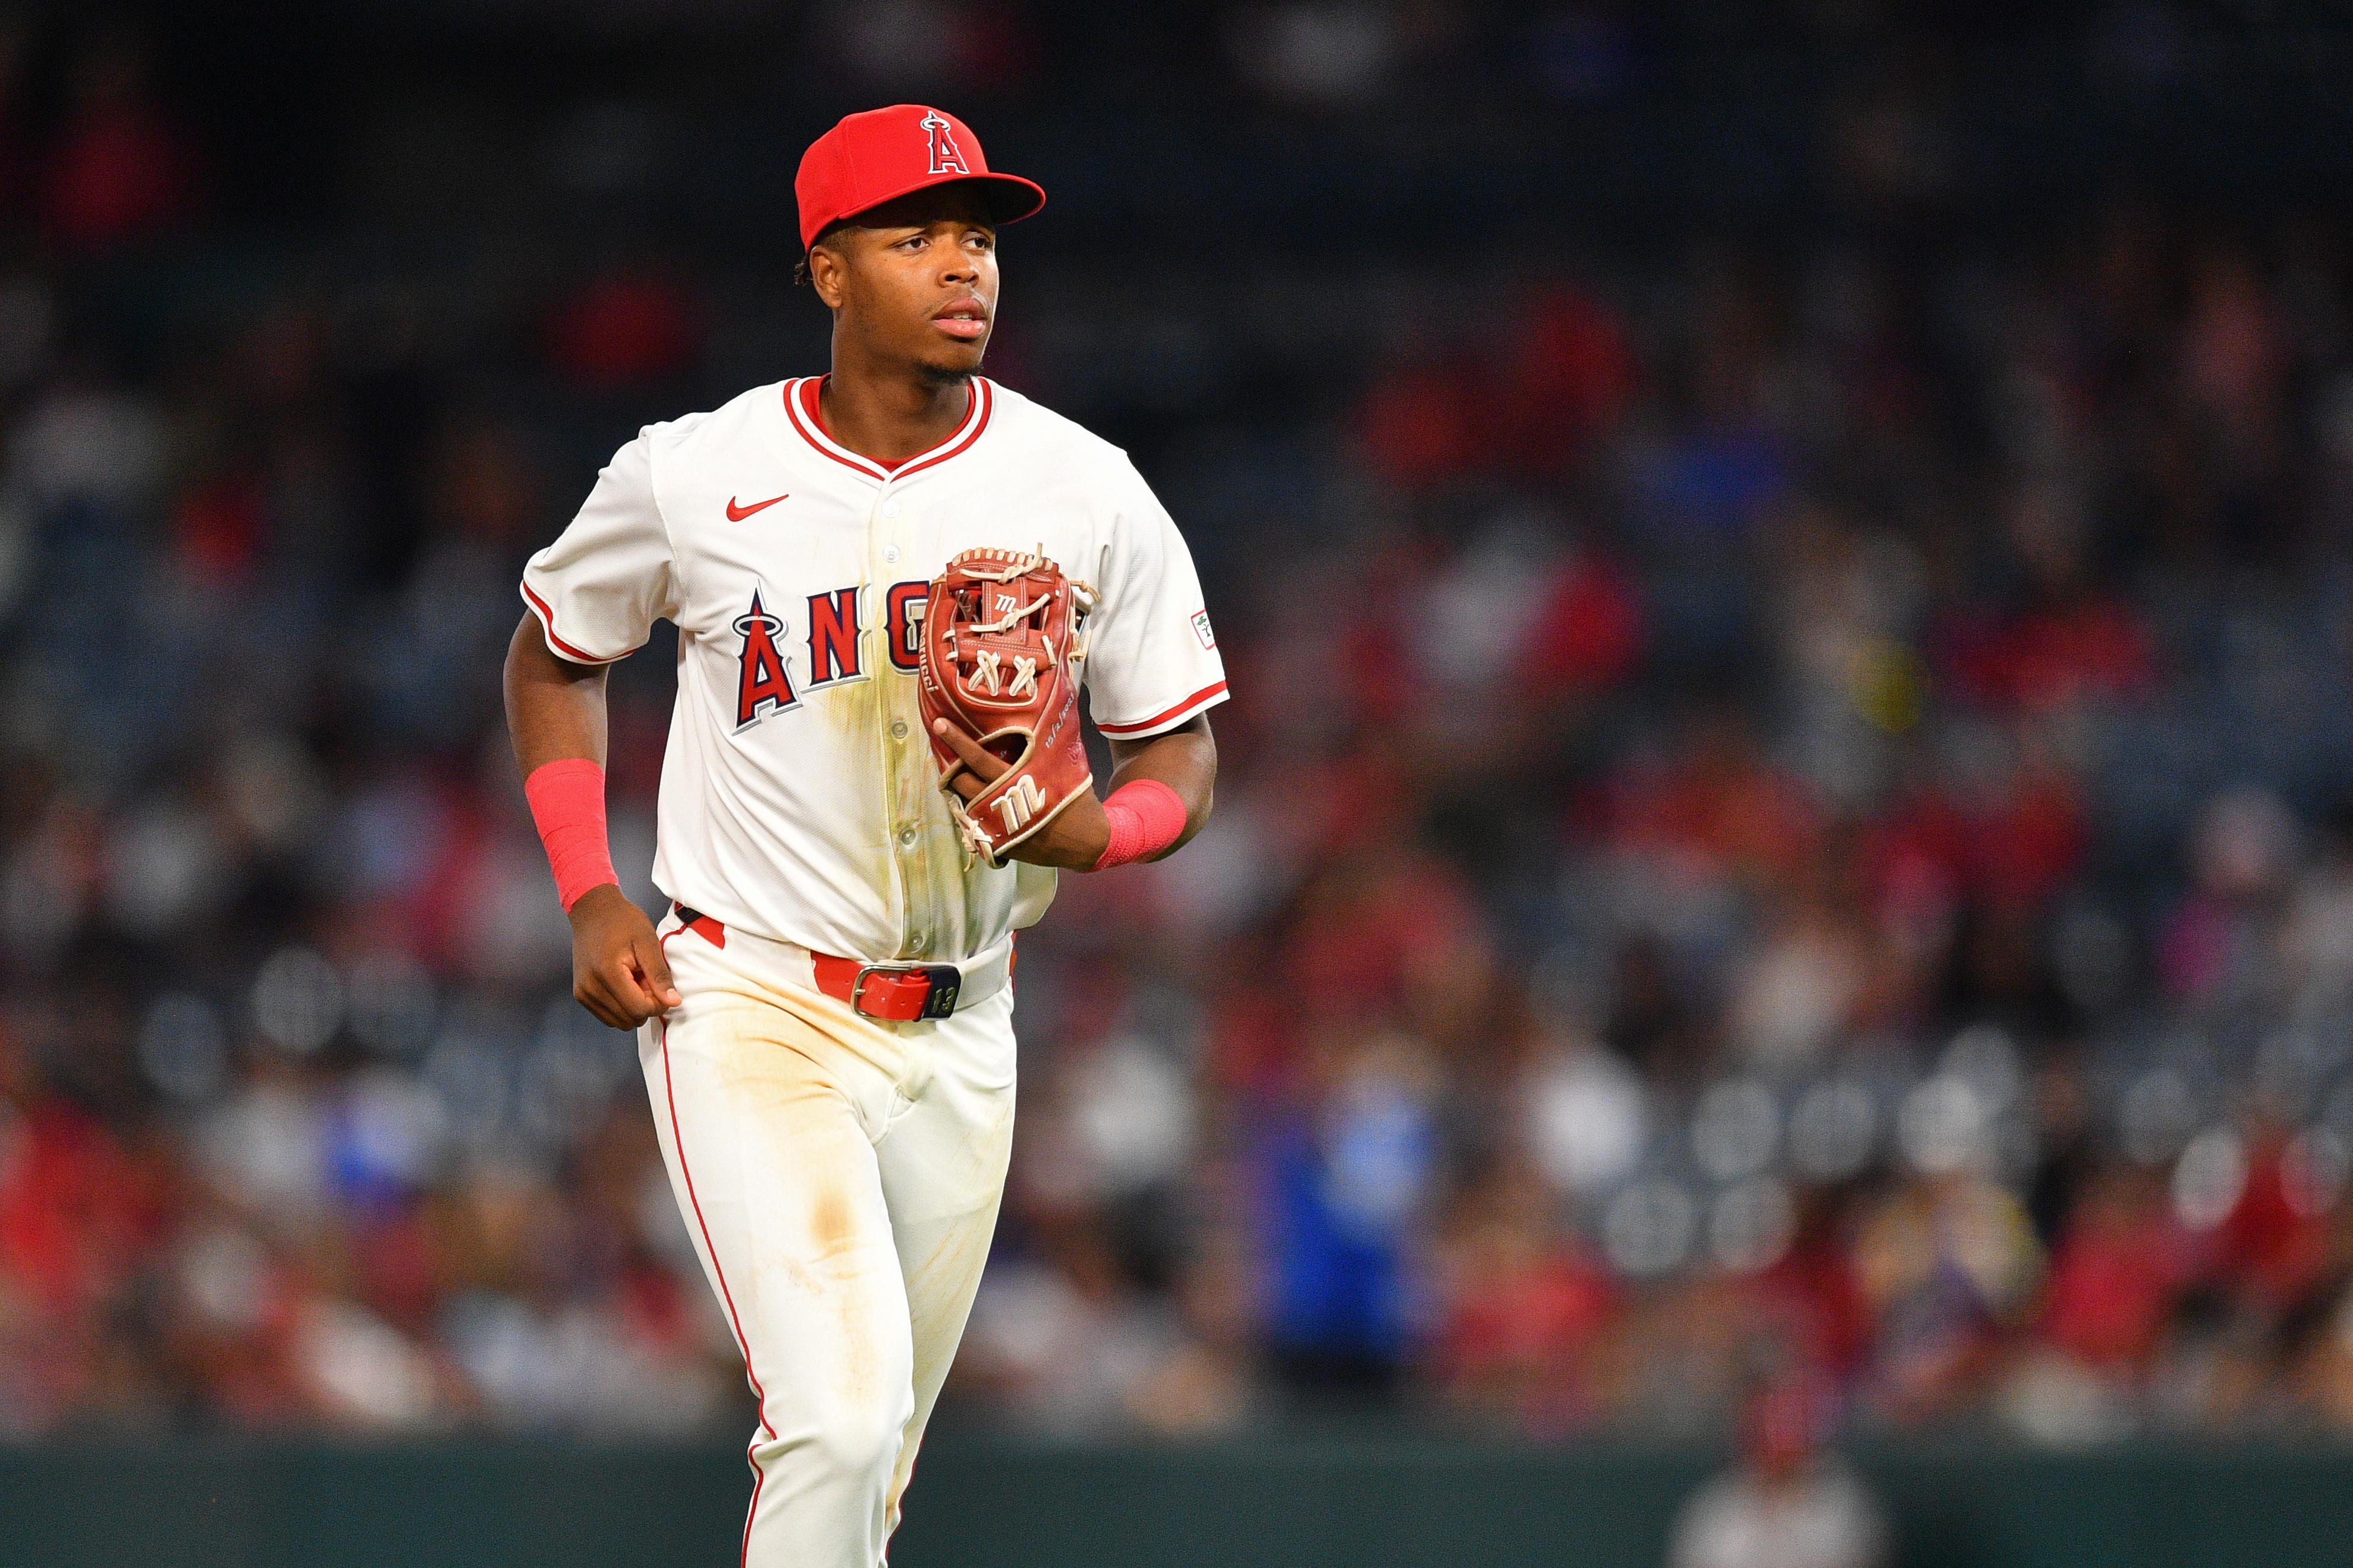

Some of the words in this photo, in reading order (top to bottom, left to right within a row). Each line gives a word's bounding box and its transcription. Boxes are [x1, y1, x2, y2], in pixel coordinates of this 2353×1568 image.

[920, 110, 970, 175] A
[919, 622, 939, 692] marucci
[932, 987, 956, 1013] 13
